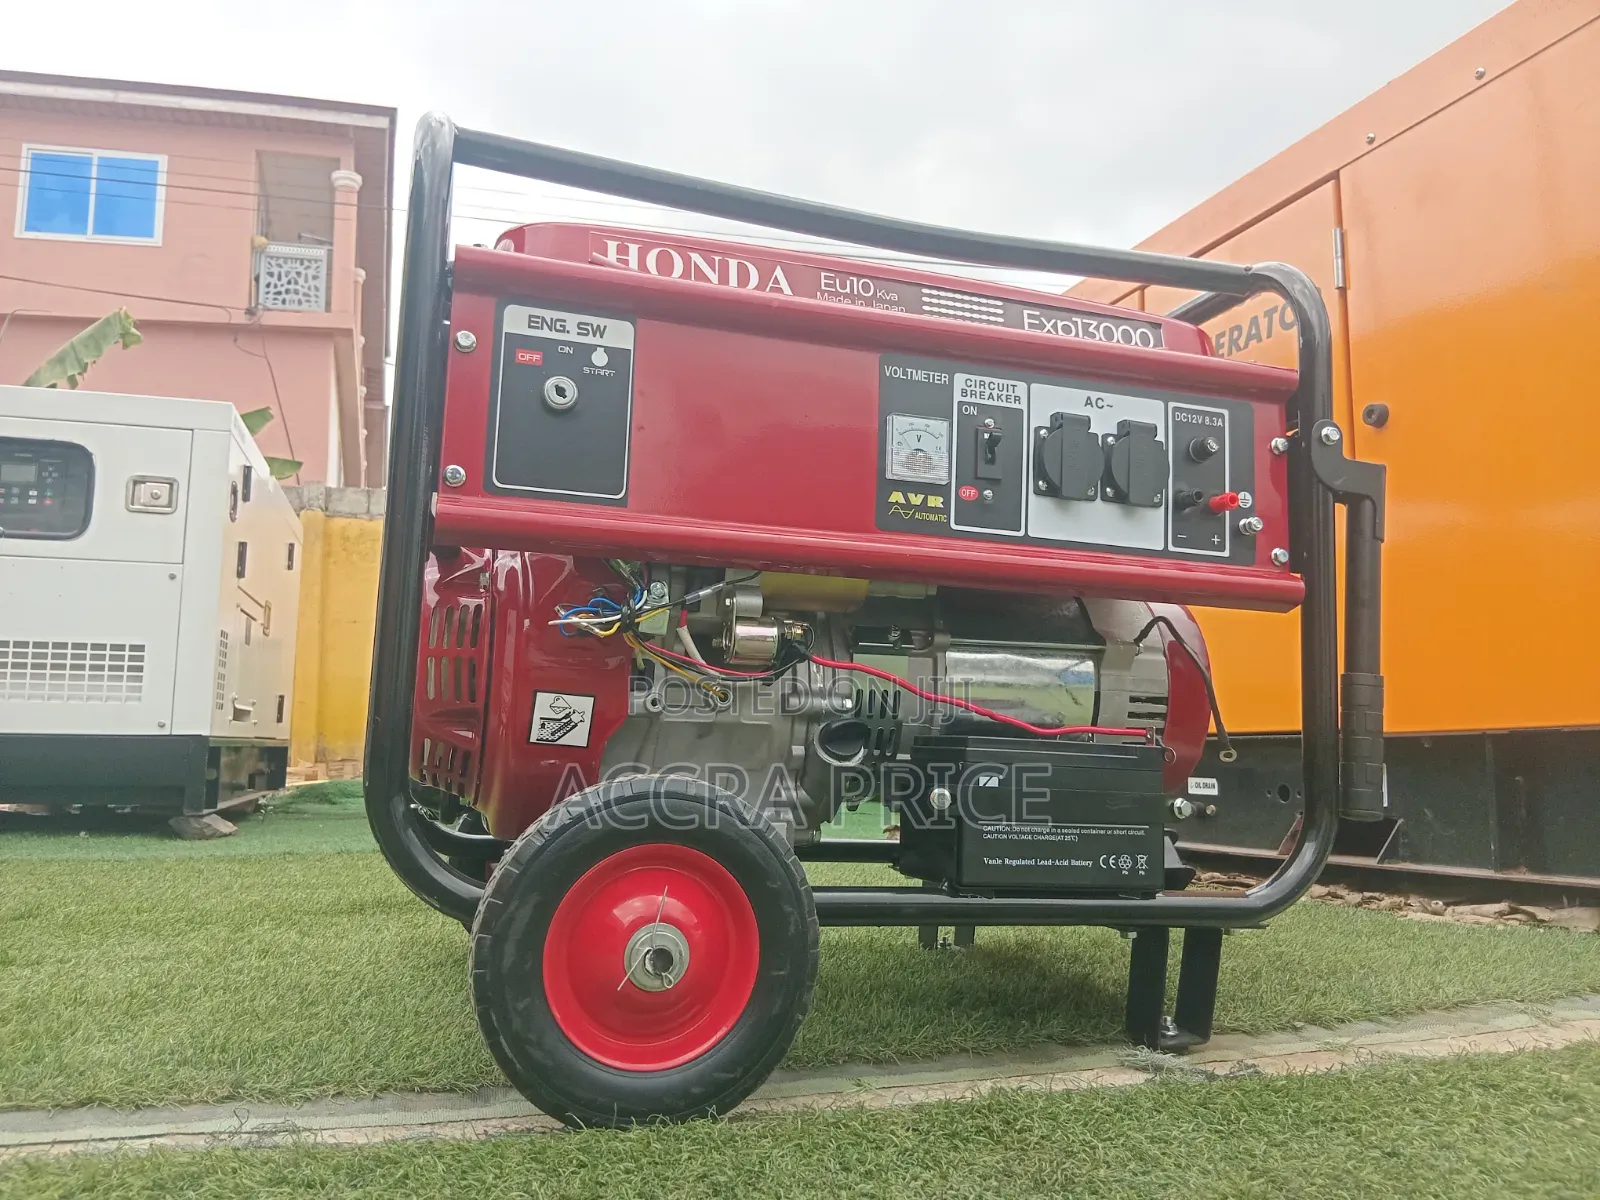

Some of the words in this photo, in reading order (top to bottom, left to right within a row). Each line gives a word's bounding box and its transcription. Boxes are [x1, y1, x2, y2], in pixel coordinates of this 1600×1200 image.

[603, 239, 793, 296] HONDA
[820, 272, 874, 297] Eu10
[876, 289, 898, 301] Kva
[527, 314, 570, 334] ENG.
[576, 321, 607, 339] SW
[1023, 309, 1155, 348] Exp13000
[518, 352, 541, 362] OFF
[558, 345, 574, 354] ON
[583, 366, 616, 377] START
[884, 365, 949, 385] VOLTMETER
[965, 378, 1018, 394] CIRCUIT
[960, 388, 1022, 405] BREAKER
[962, 405, 978, 416] ON
[1174, 412, 1202, 424] DC12V
[1204, 416, 1224, 428] 8.3A
[916, 434, 922, 443] V
[888, 491, 945, 509] AVR
[961, 489, 976, 498] OFF
[914, 511, 948, 523] AUTOMATIC
[983, 857, 1003, 865] Vanle
[1004, 858, 1035, 867] Regulated
[1070, 860, 1093, 868] Battery
